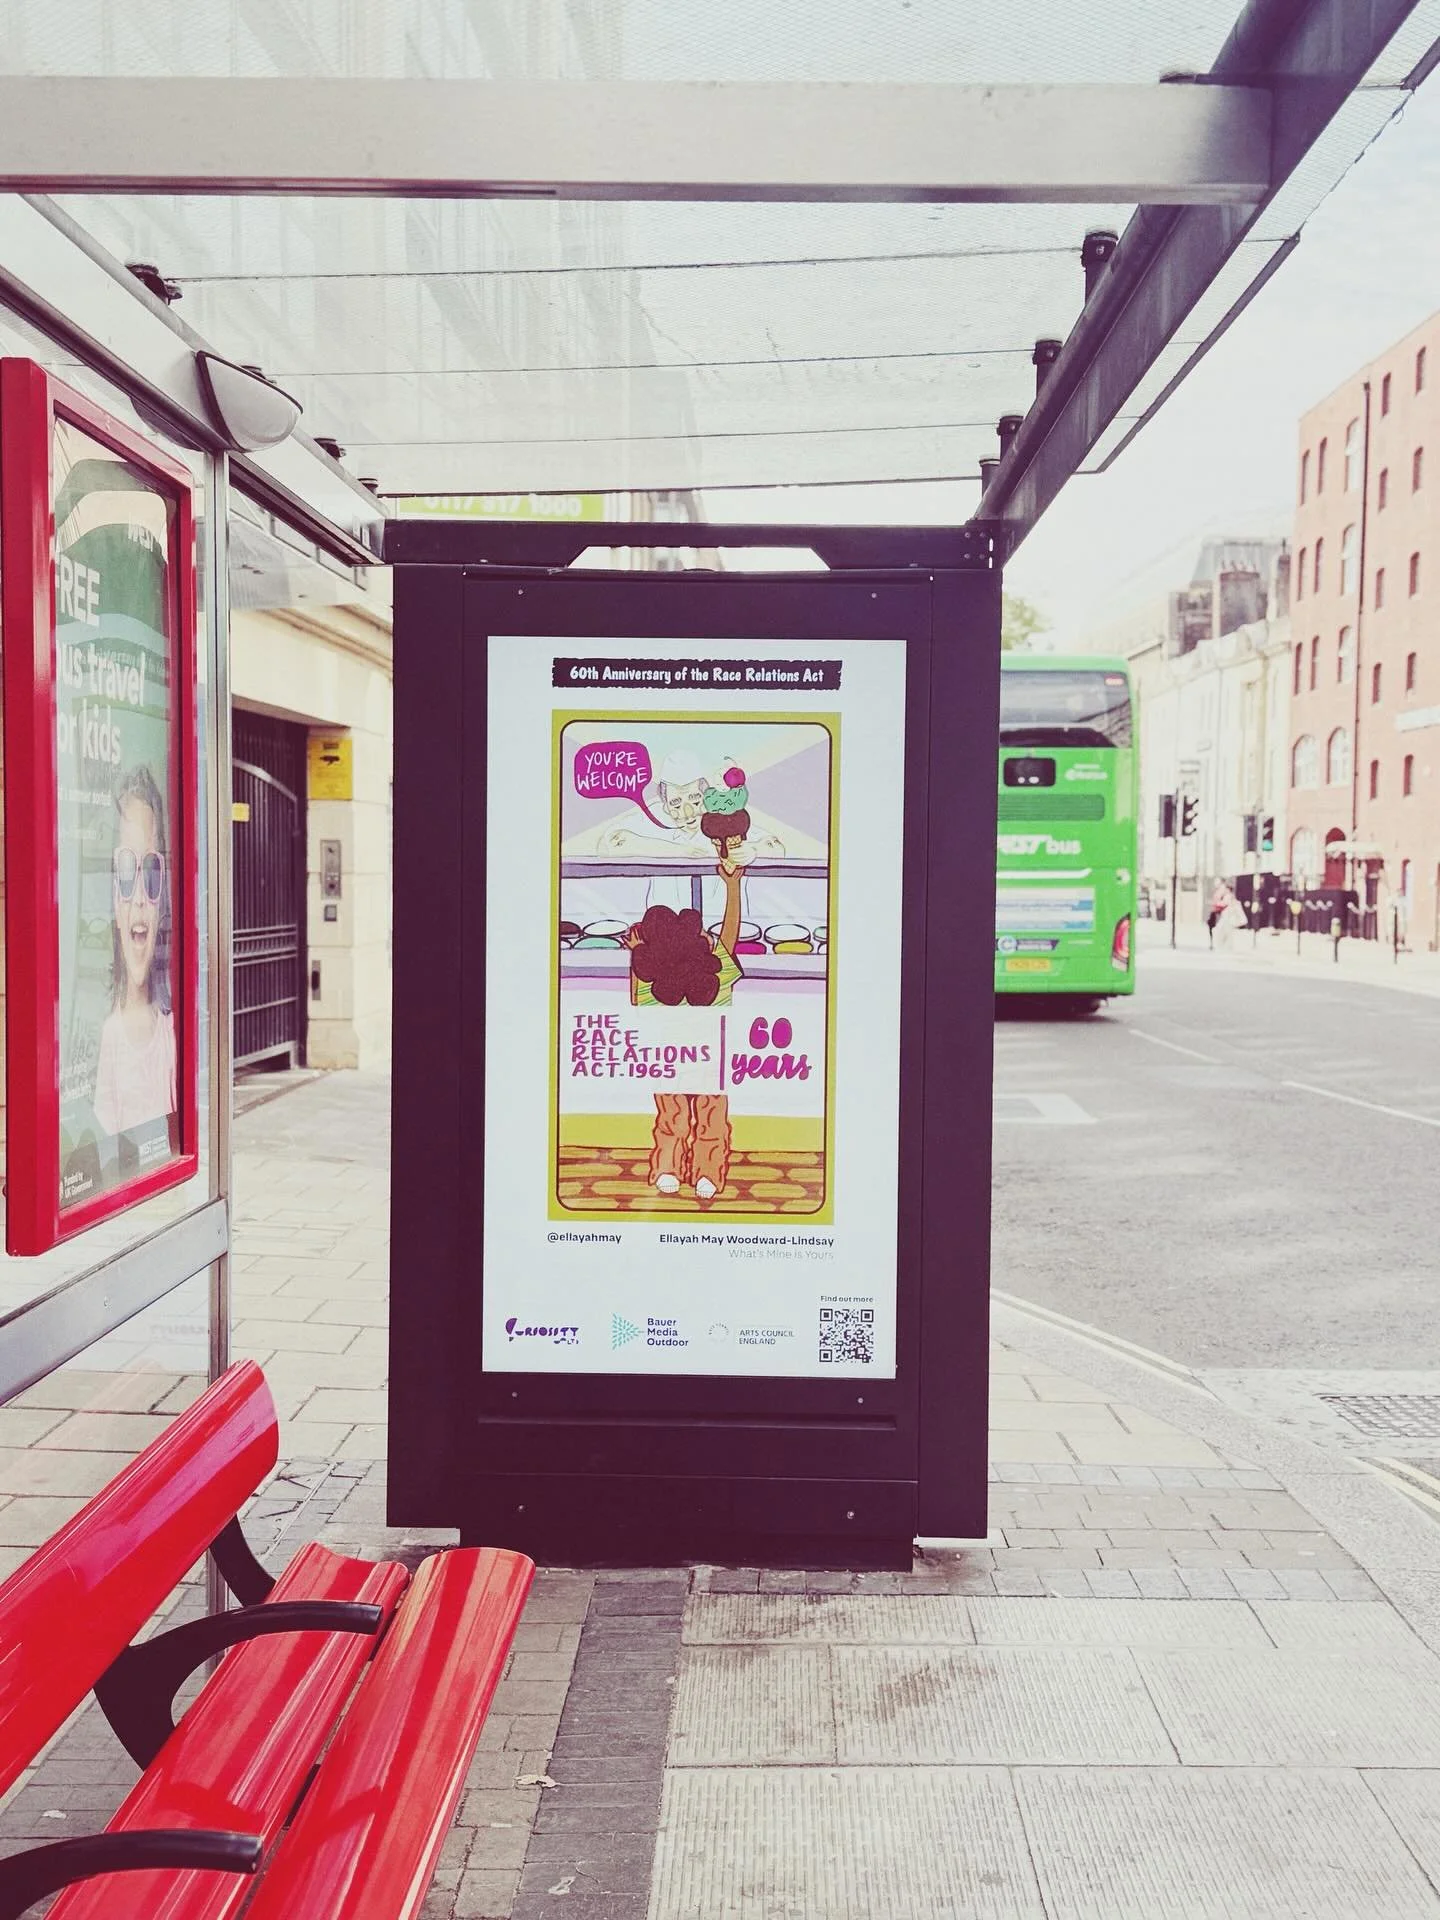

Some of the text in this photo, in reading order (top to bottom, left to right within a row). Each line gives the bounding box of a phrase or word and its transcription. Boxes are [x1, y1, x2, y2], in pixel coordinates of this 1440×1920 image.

[58, 641, 82, 689] us
[88, 643, 145, 707] travel
[570, 666, 824, 683] 60th Anniversary of the Race Relations Act
[58, 698, 120, 765] or kids
[585, 751, 638, 773] YOU'RE
[577, 767, 647, 792] WELCOME
[573, 1014, 620, 1028] THE
[572, 1029, 639, 1046] RACE
[749, 1016, 793, 1049] 60
[571, 1045, 712, 1063] RELATIONS
[731, 1053, 812, 1085] years
[547, 1232, 622, 1244] @ellayahmay
[659, 1234, 834, 1247] Ellayah May Woodward-Lindsay
[728, 1249, 834, 1260] What's Mine is Yours
[647, 1318, 677, 1327] Bauer
[647, 1328, 678, 1337] Media
[739, 1329, 795, 1338] ARTS COUNCIL
[647, 1338, 689, 1347] Outdoor
[739, 1337, 776, 1345] ENGLAND
